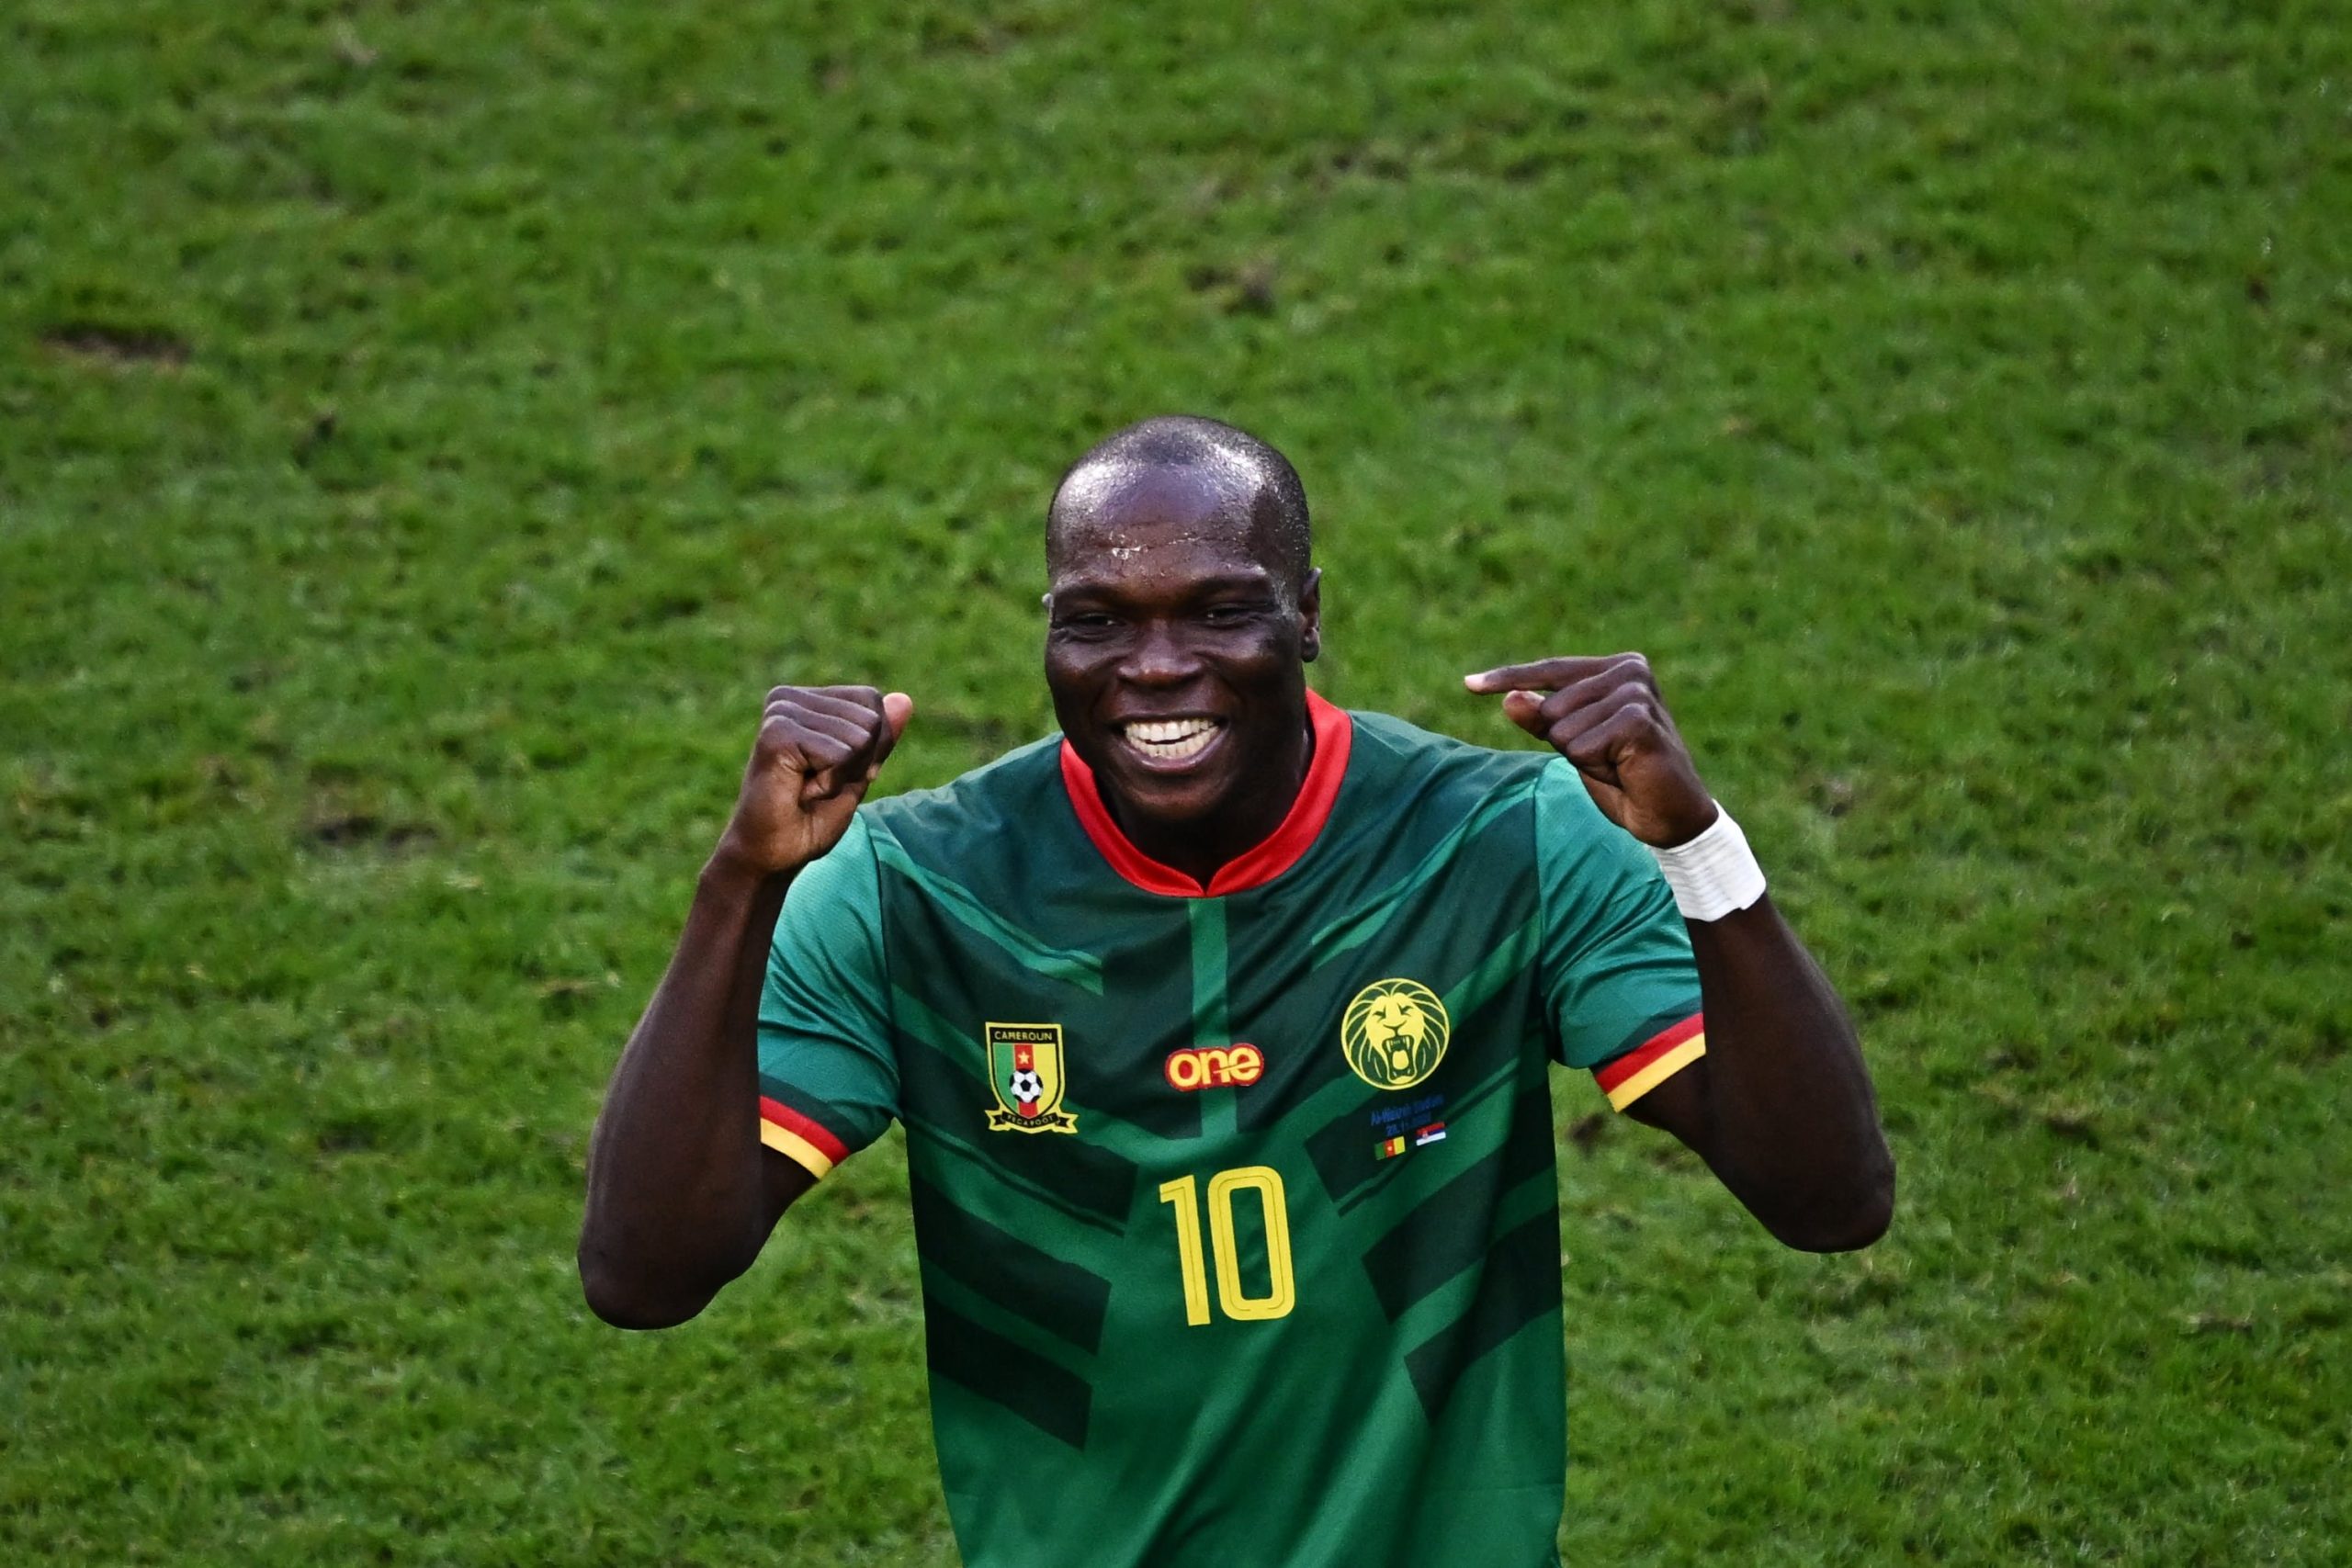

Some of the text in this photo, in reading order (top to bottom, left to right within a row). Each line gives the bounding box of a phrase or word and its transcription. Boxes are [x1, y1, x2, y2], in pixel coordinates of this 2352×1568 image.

[994, 1031, 1053, 1041] CAMEROUN
[1169, 1047, 1261, 1087] one
[1159, 1166, 1295, 1326] 10
